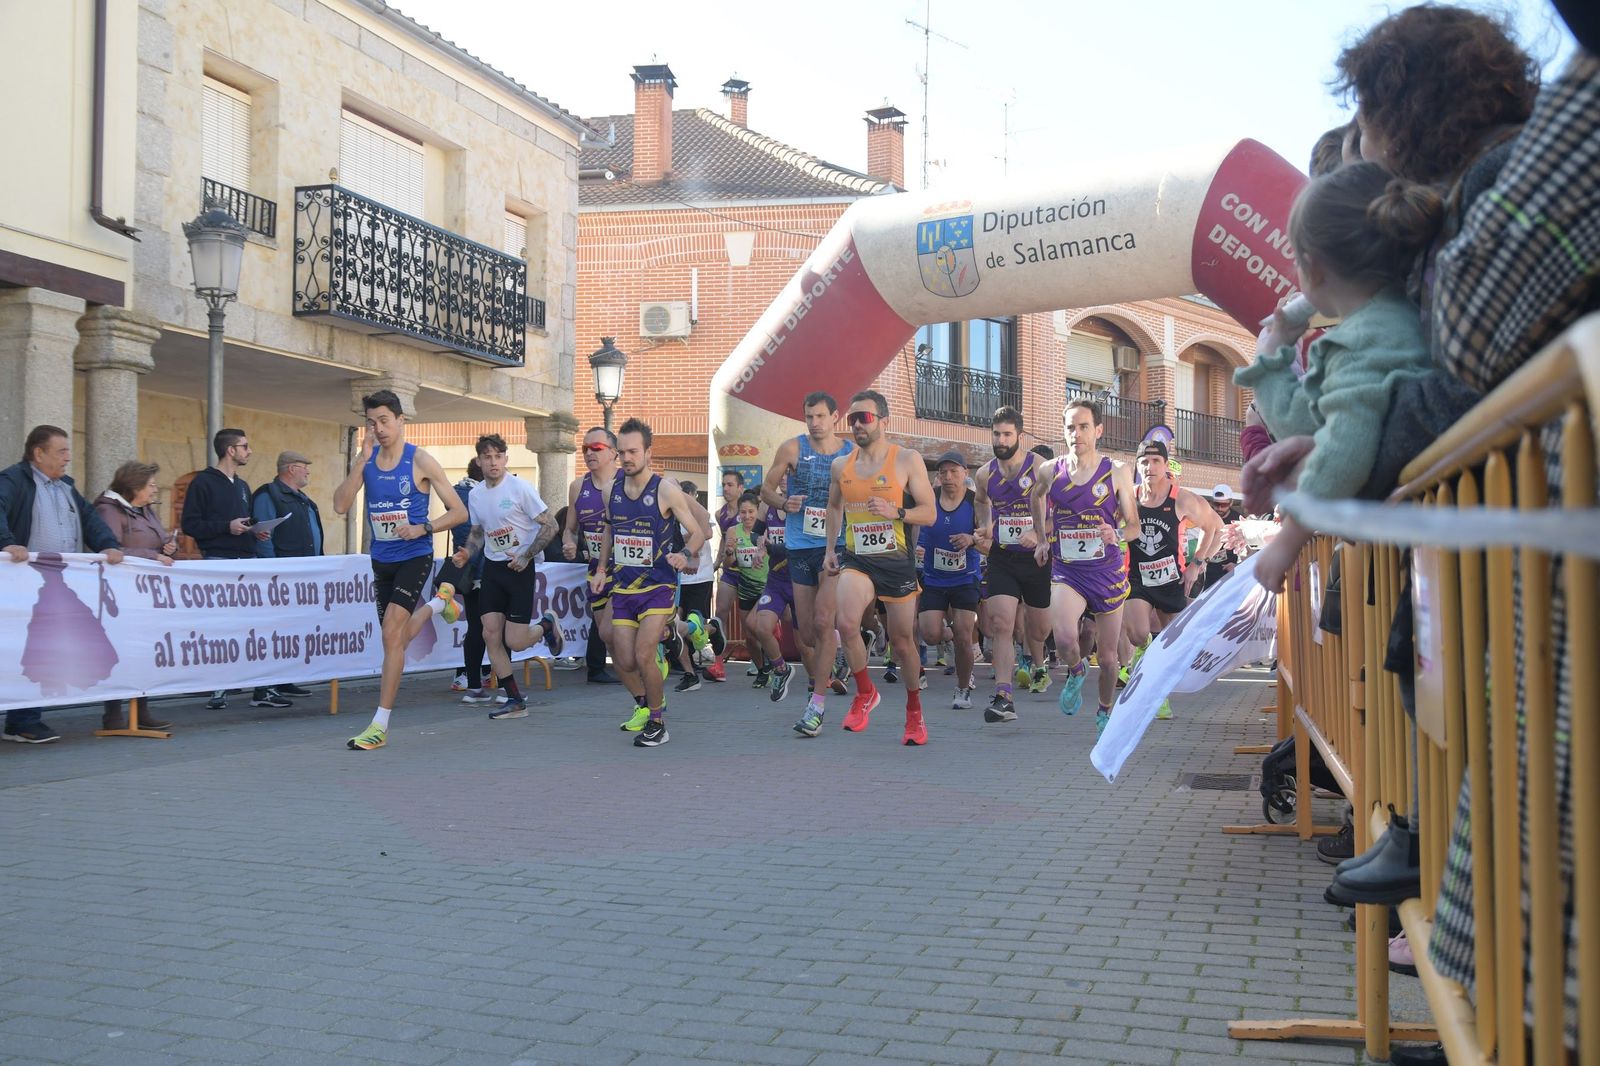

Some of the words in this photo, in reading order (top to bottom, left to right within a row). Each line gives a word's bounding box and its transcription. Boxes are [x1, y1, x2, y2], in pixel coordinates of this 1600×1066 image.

[983, 196, 1106, 234] Diputación
[1220, 193, 1269, 234] CON
[1264, 228, 1297, 260] NU
[986, 252, 1006, 269] de
[1014, 232, 1136, 264] Salamanca
[732, 352, 766, 394] CON
[765, 333, 786, 356] EL
[783, 246, 855, 331] DEPORTE
[370, 512, 407, 521] bedunia
[852, 522, 893, 534] bedunia
[1008, 526, 1022, 537] 99
[494, 534, 512, 546] 157
[615, 536, 652, 547] bedunia
[862, 532, 886, 546] 286
[1078, 541, 1086, 552] 2
[622, 547, 644, 559] 152
[942, 557, 959, 566] 161
[1140, 558, 1174, 570] bedunia
[1148, 567, 1170, 580] 271
[135, 574, 176, 609] “El
[180, 574, 264, 608] corazón
[268, 575, 290, 606] de
[294, 580, 319, 606] un
[154, 632, 175, 668] al
[180, 630, 240, 666] ritmo
[245, 629, 267, 662] de
[271, 630, 300, 659] tus
[304, 622, 372, 664] piernas”
